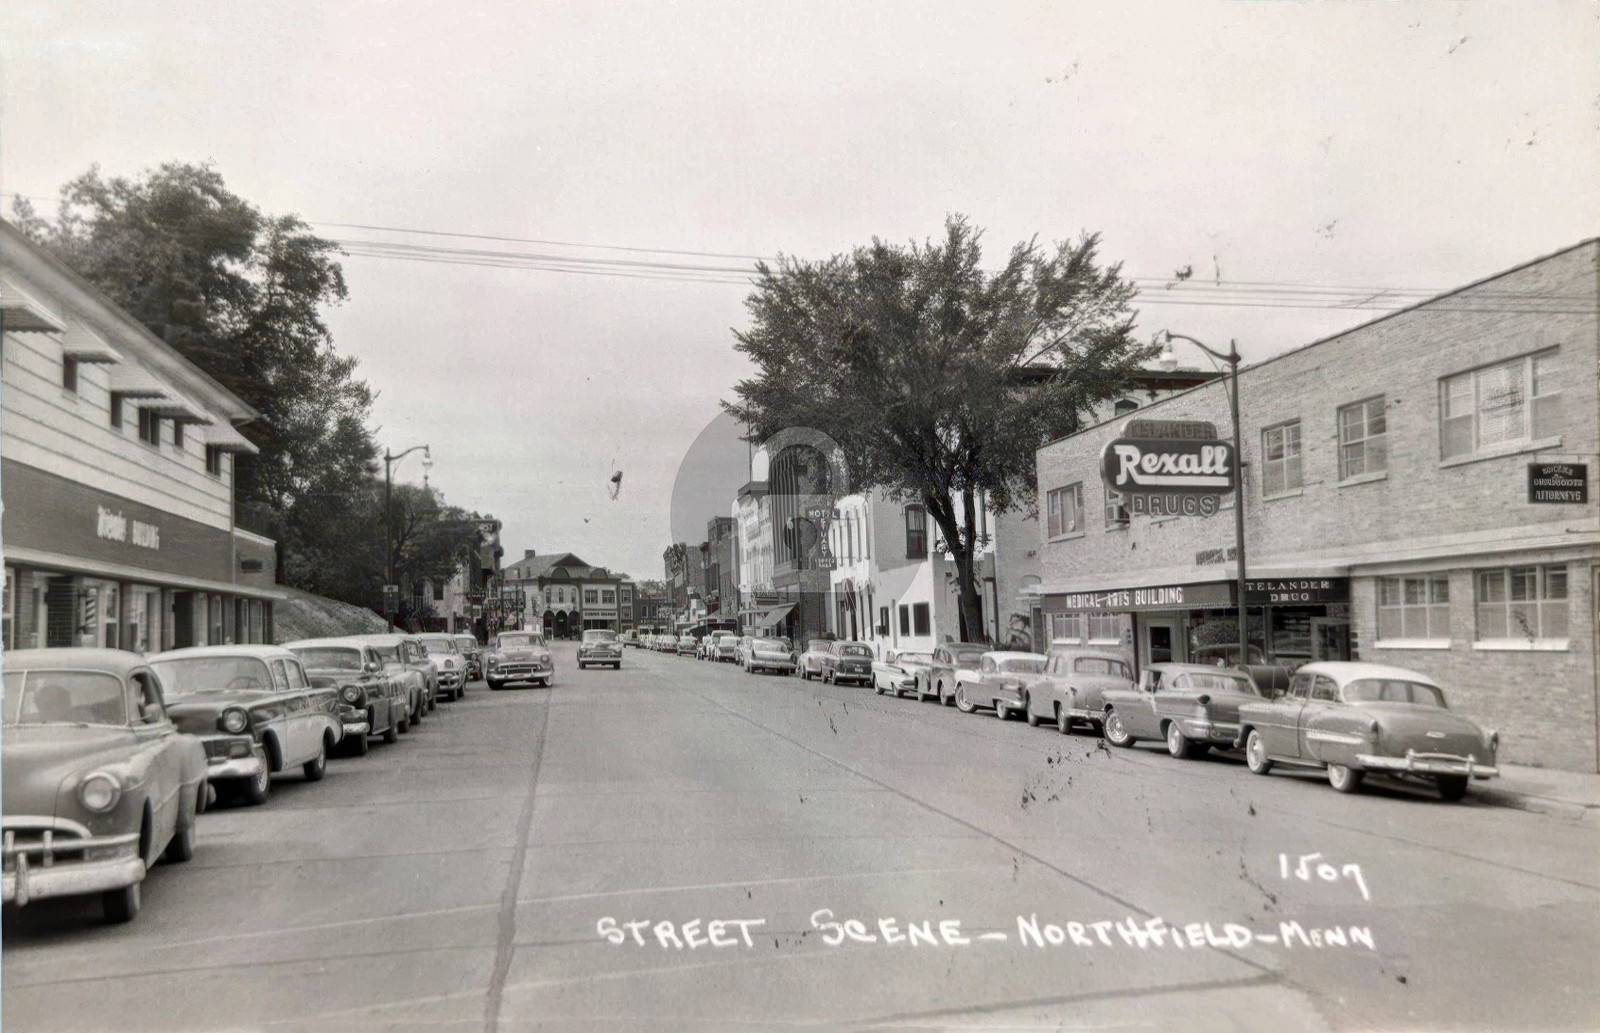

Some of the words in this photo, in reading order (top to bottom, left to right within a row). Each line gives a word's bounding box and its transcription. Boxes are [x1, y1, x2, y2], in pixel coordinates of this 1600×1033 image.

[1114, 444, 1229, 486] Rexall
[1132, 494, 1217, 517] DRUGS
[1245, 580, 1330, 591] TELANDER
[1066, 592, 1101, 609] MEDICAL
[1135, 586, 1184, 606] BUILDING
